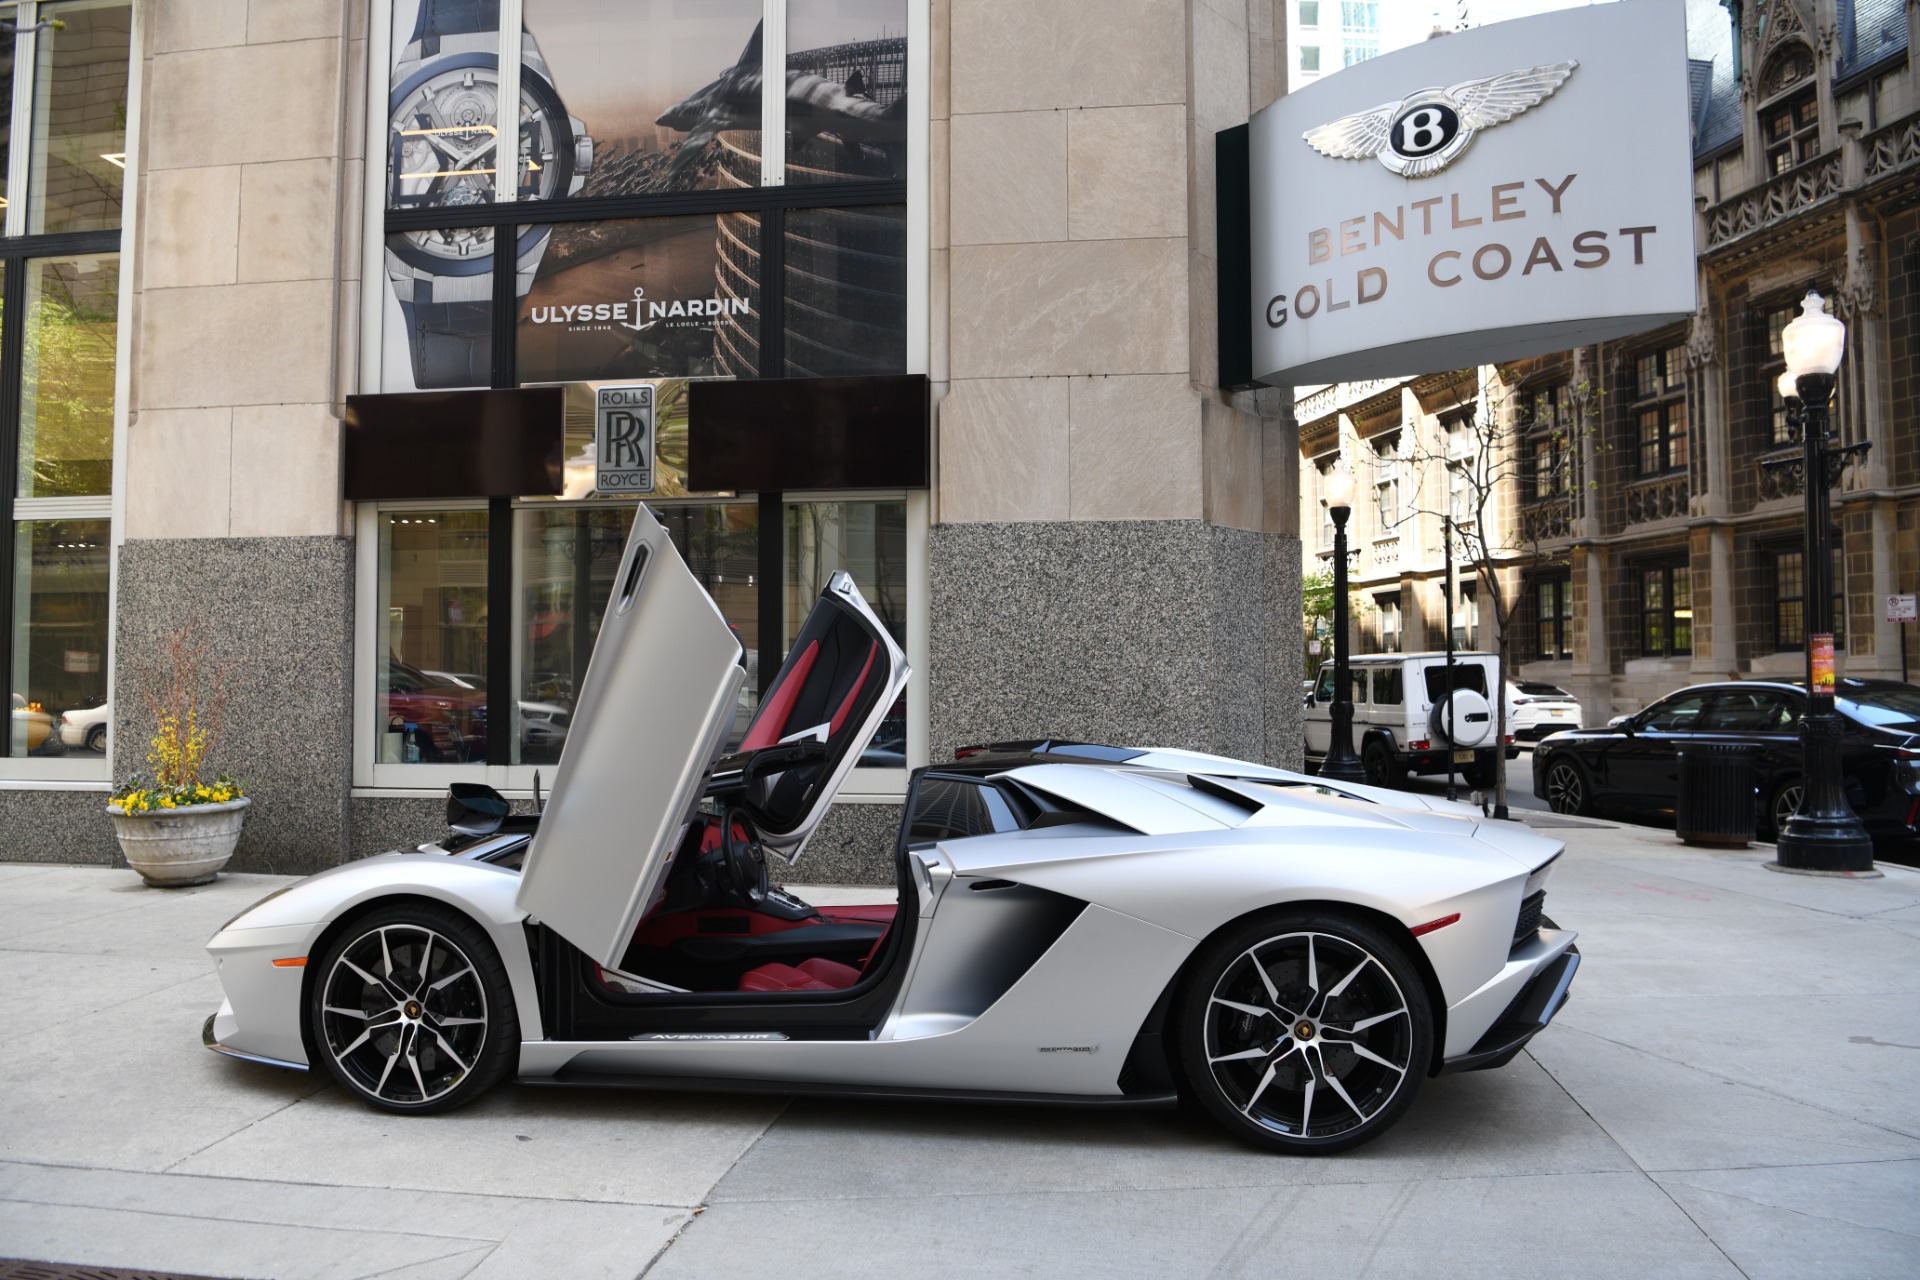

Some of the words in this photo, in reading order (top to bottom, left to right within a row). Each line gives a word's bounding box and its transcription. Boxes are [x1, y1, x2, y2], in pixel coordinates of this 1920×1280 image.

[1402, 108, 1445, 152] B
[1308, 173, 1578, 266] BENTLEY
[1265, 266, 1388, 329] GOLD
[1427, 225, 1657, 288] COAST
[531, 303, 628, 324] ULYSSE
[649, 297, 750, 319] NARDIN
[602, 391, 648, 405] ROLLS
[601, 474, 647, 486] ROYCE
